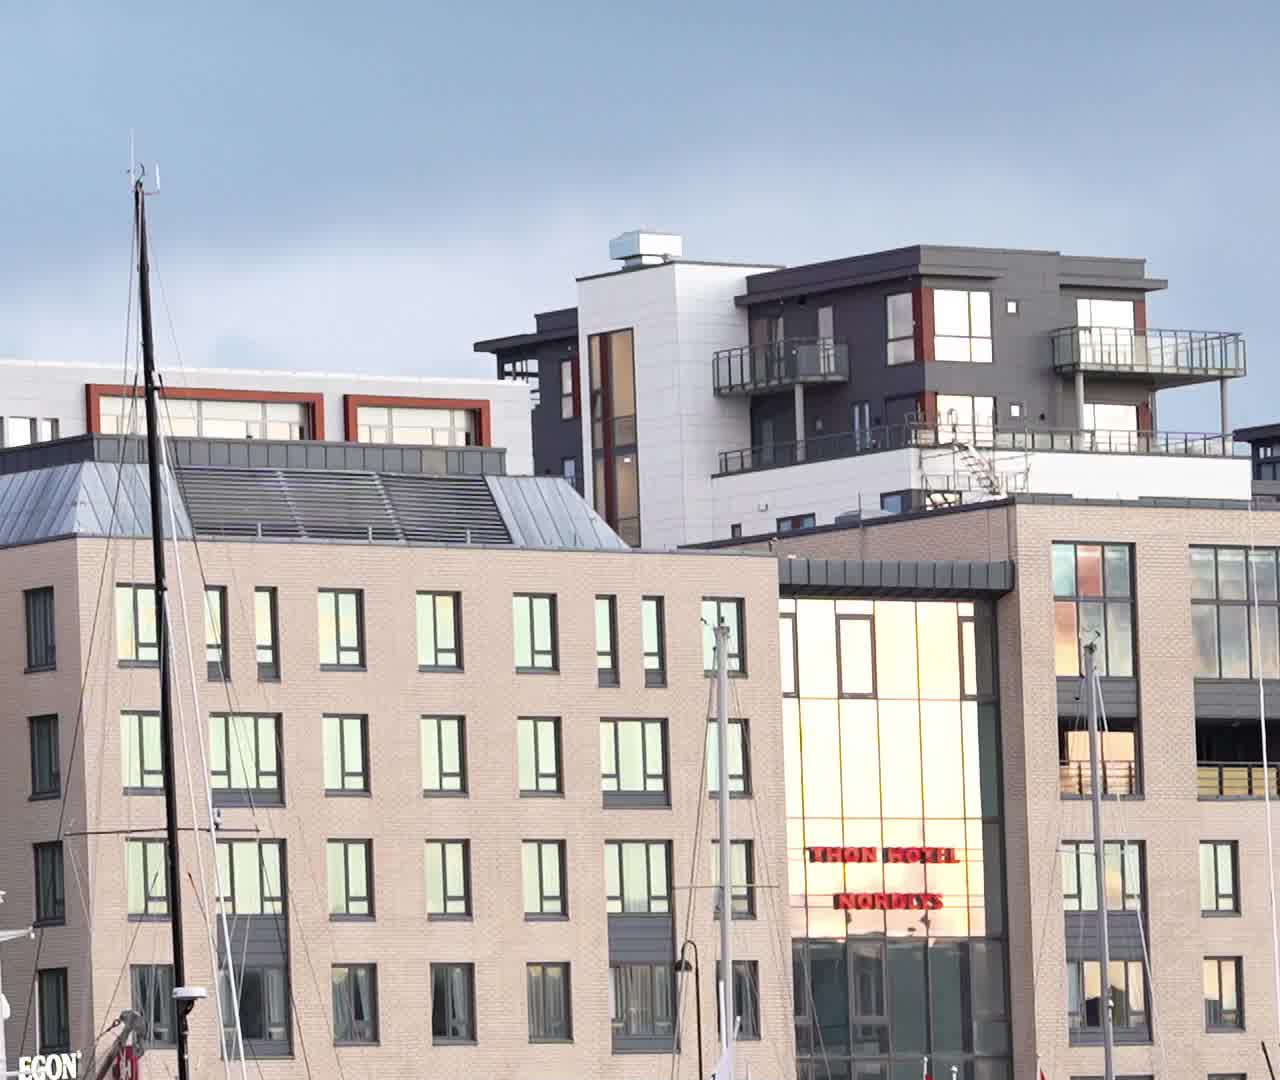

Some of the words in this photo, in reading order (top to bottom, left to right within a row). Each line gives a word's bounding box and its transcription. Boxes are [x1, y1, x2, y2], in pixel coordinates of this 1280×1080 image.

[808, 846, 877, 863] THON
[883, 846, 960, 864] HOTEL
[834, 892, 944, 910] NORDLYS
